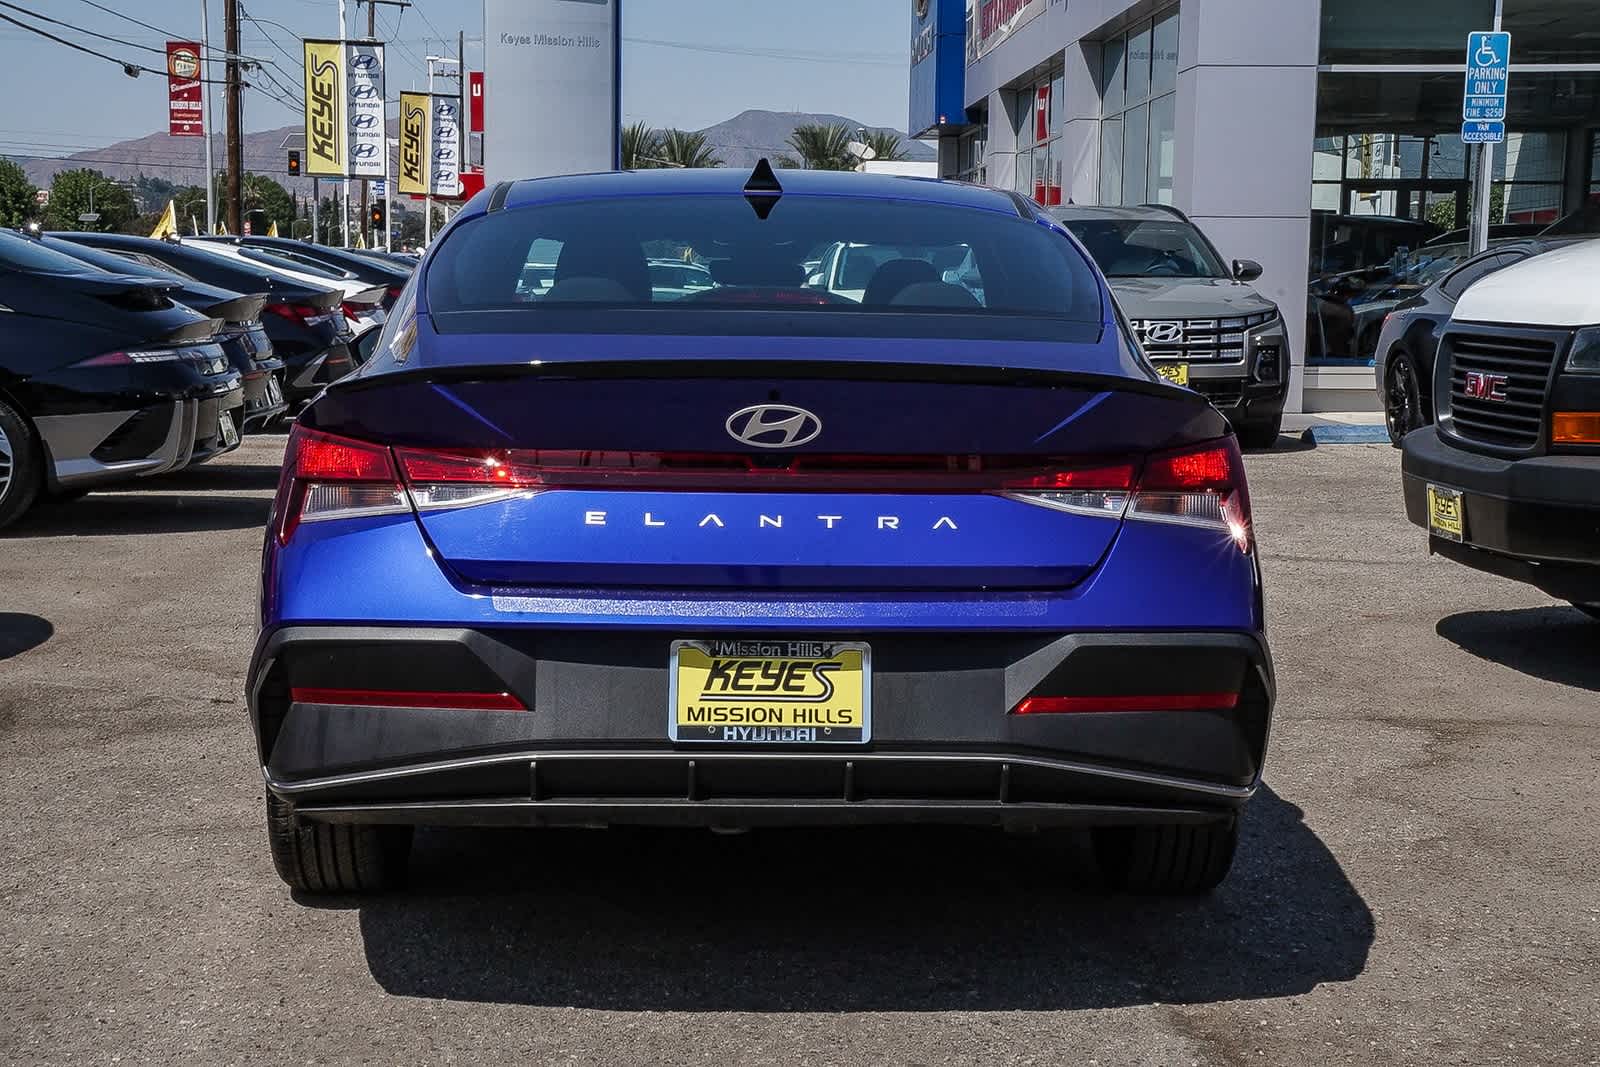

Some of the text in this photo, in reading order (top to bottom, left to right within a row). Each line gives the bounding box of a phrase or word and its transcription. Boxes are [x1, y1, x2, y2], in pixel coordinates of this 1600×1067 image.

[500, 32, 601, 48] Keyes Mission Hills
[1468, 67, 1506, 81] PARKING
[1474, 81, 1498, 94] ONLY
[310, 52, 341, 166] KEYES
[1471, 98, 1499, 107] MINIMUM
[1466, 107, 1481, 117] FINE
[1476, 123, 1490, 131] VAN
[403, 101, 426, 186] KEYES
[1463, 132, 1502, 141] ACCESSIBLE
[1463, 371, 1509, 402] GMC
[584, 511, 959, 530] ELANTRA
[719, 642, 822, 658] Mission Hills
[699, 659, 844, 704] KEYES
[687, 706, 853, 724] MISSION HILLS
[723, 726, 817, 742] HYUNDAI
